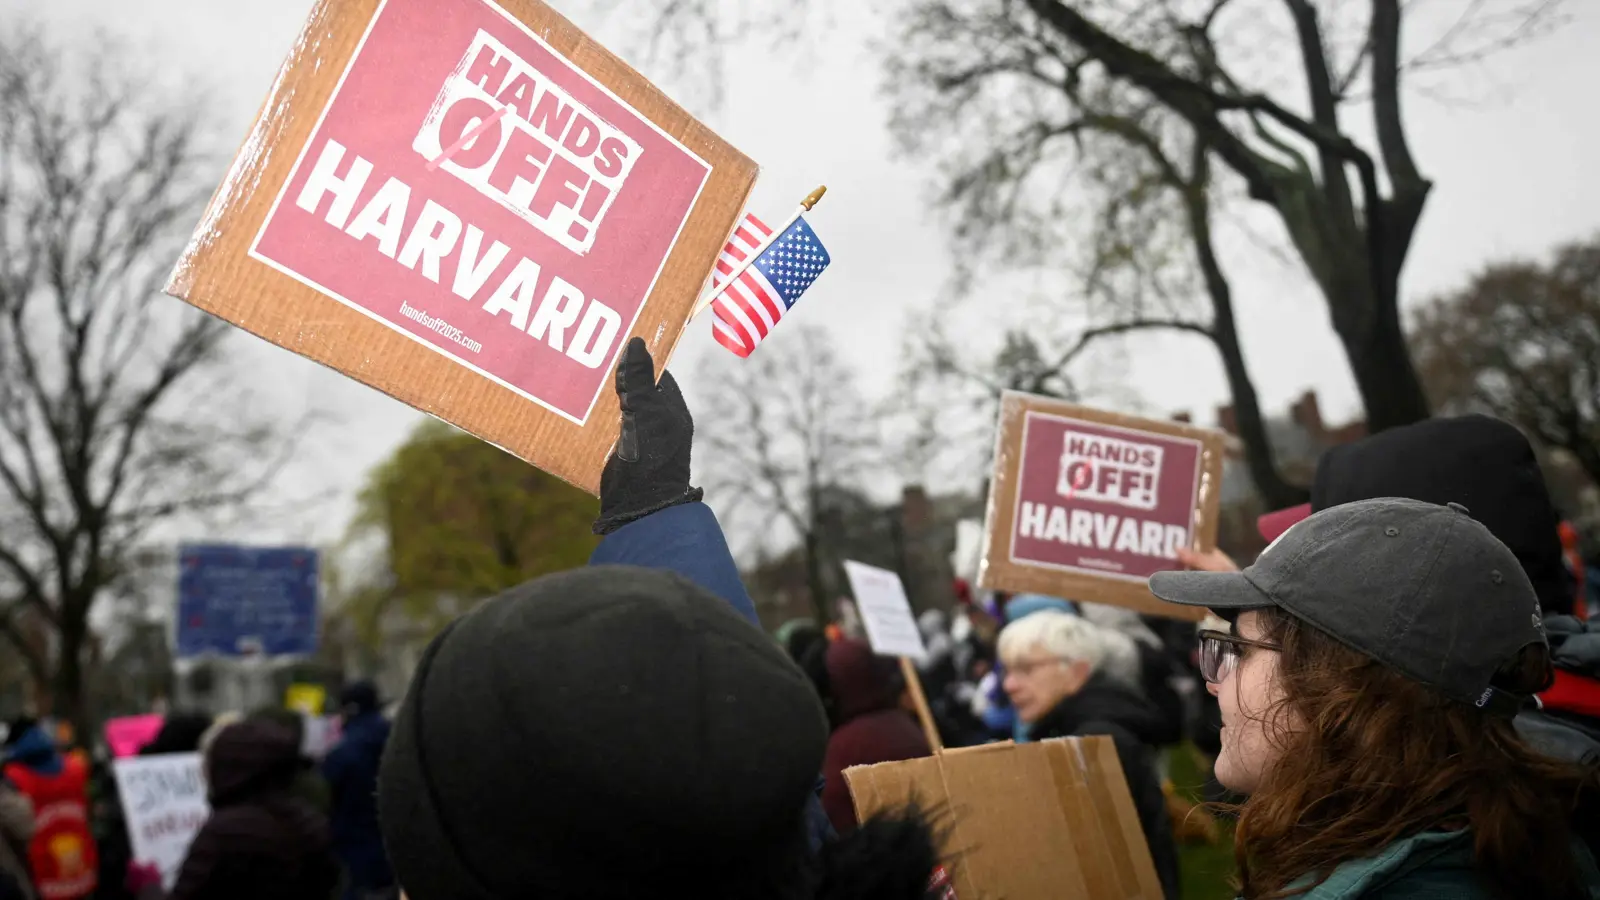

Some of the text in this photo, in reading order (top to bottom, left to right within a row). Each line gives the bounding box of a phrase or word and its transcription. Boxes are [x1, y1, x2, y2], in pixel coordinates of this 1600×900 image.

[466, 43, 628, 178] HANDS
[438, 96, 614, 243] OFF!
[295, 137, 622, 370] HARVARD
[399, 300, 482, 354] handsoff2025.com
[1069, 439, 1155, 467] HANDS
[1066, 461, 1154, 502] OFF!
[1020, 503, 1187, 559] HARVARD
